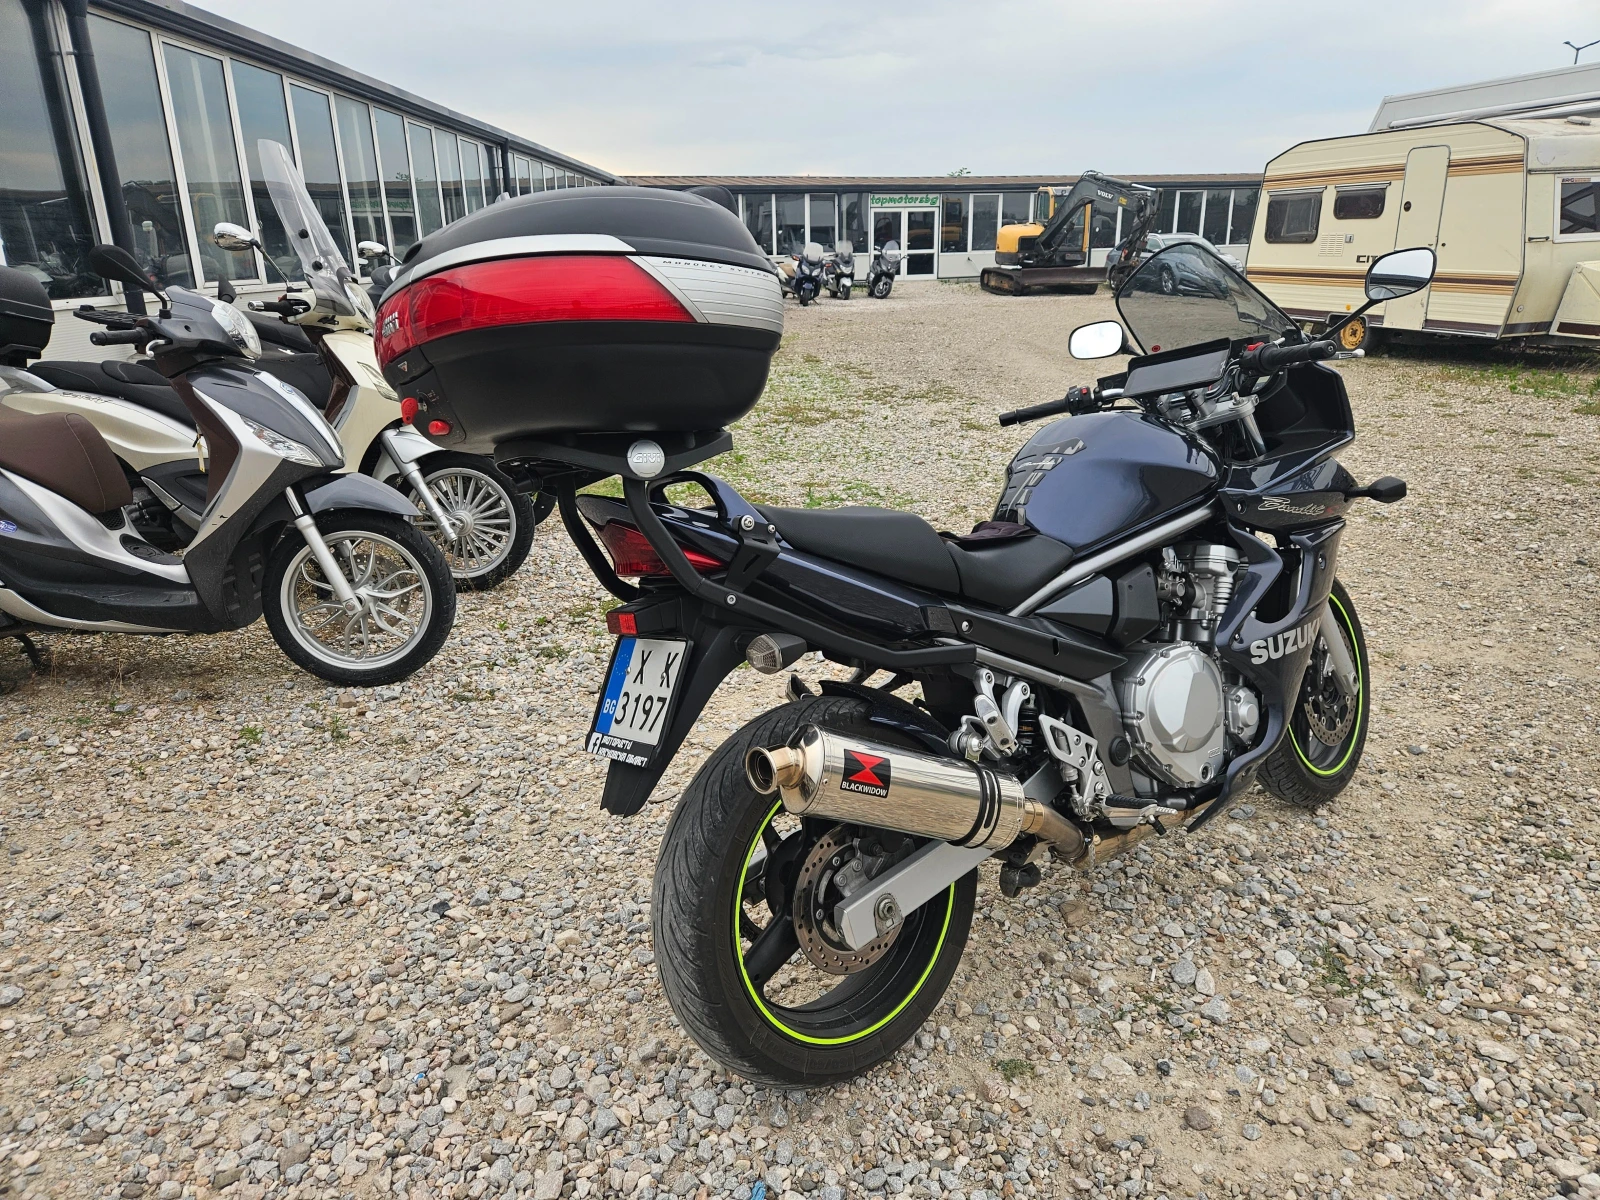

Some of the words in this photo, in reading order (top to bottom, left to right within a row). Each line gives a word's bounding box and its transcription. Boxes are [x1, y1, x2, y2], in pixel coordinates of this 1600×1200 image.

[871, 194, 939, 206] topmotorsbg
[1356, 254, 1380, 263] CIT
[730, 267, 769, 278] SYSTEM
[632, 452, 662, 464] GIVI
[1257, 496, 1326, 516] Bandit
[632, 650, 652, 685] X
[659, 652, 679, 688] K
[603, 698, 617, 714] BG
[614, 691, 667, 733] 3197
[841, 781, 887, 797] BLACKWIDOW
